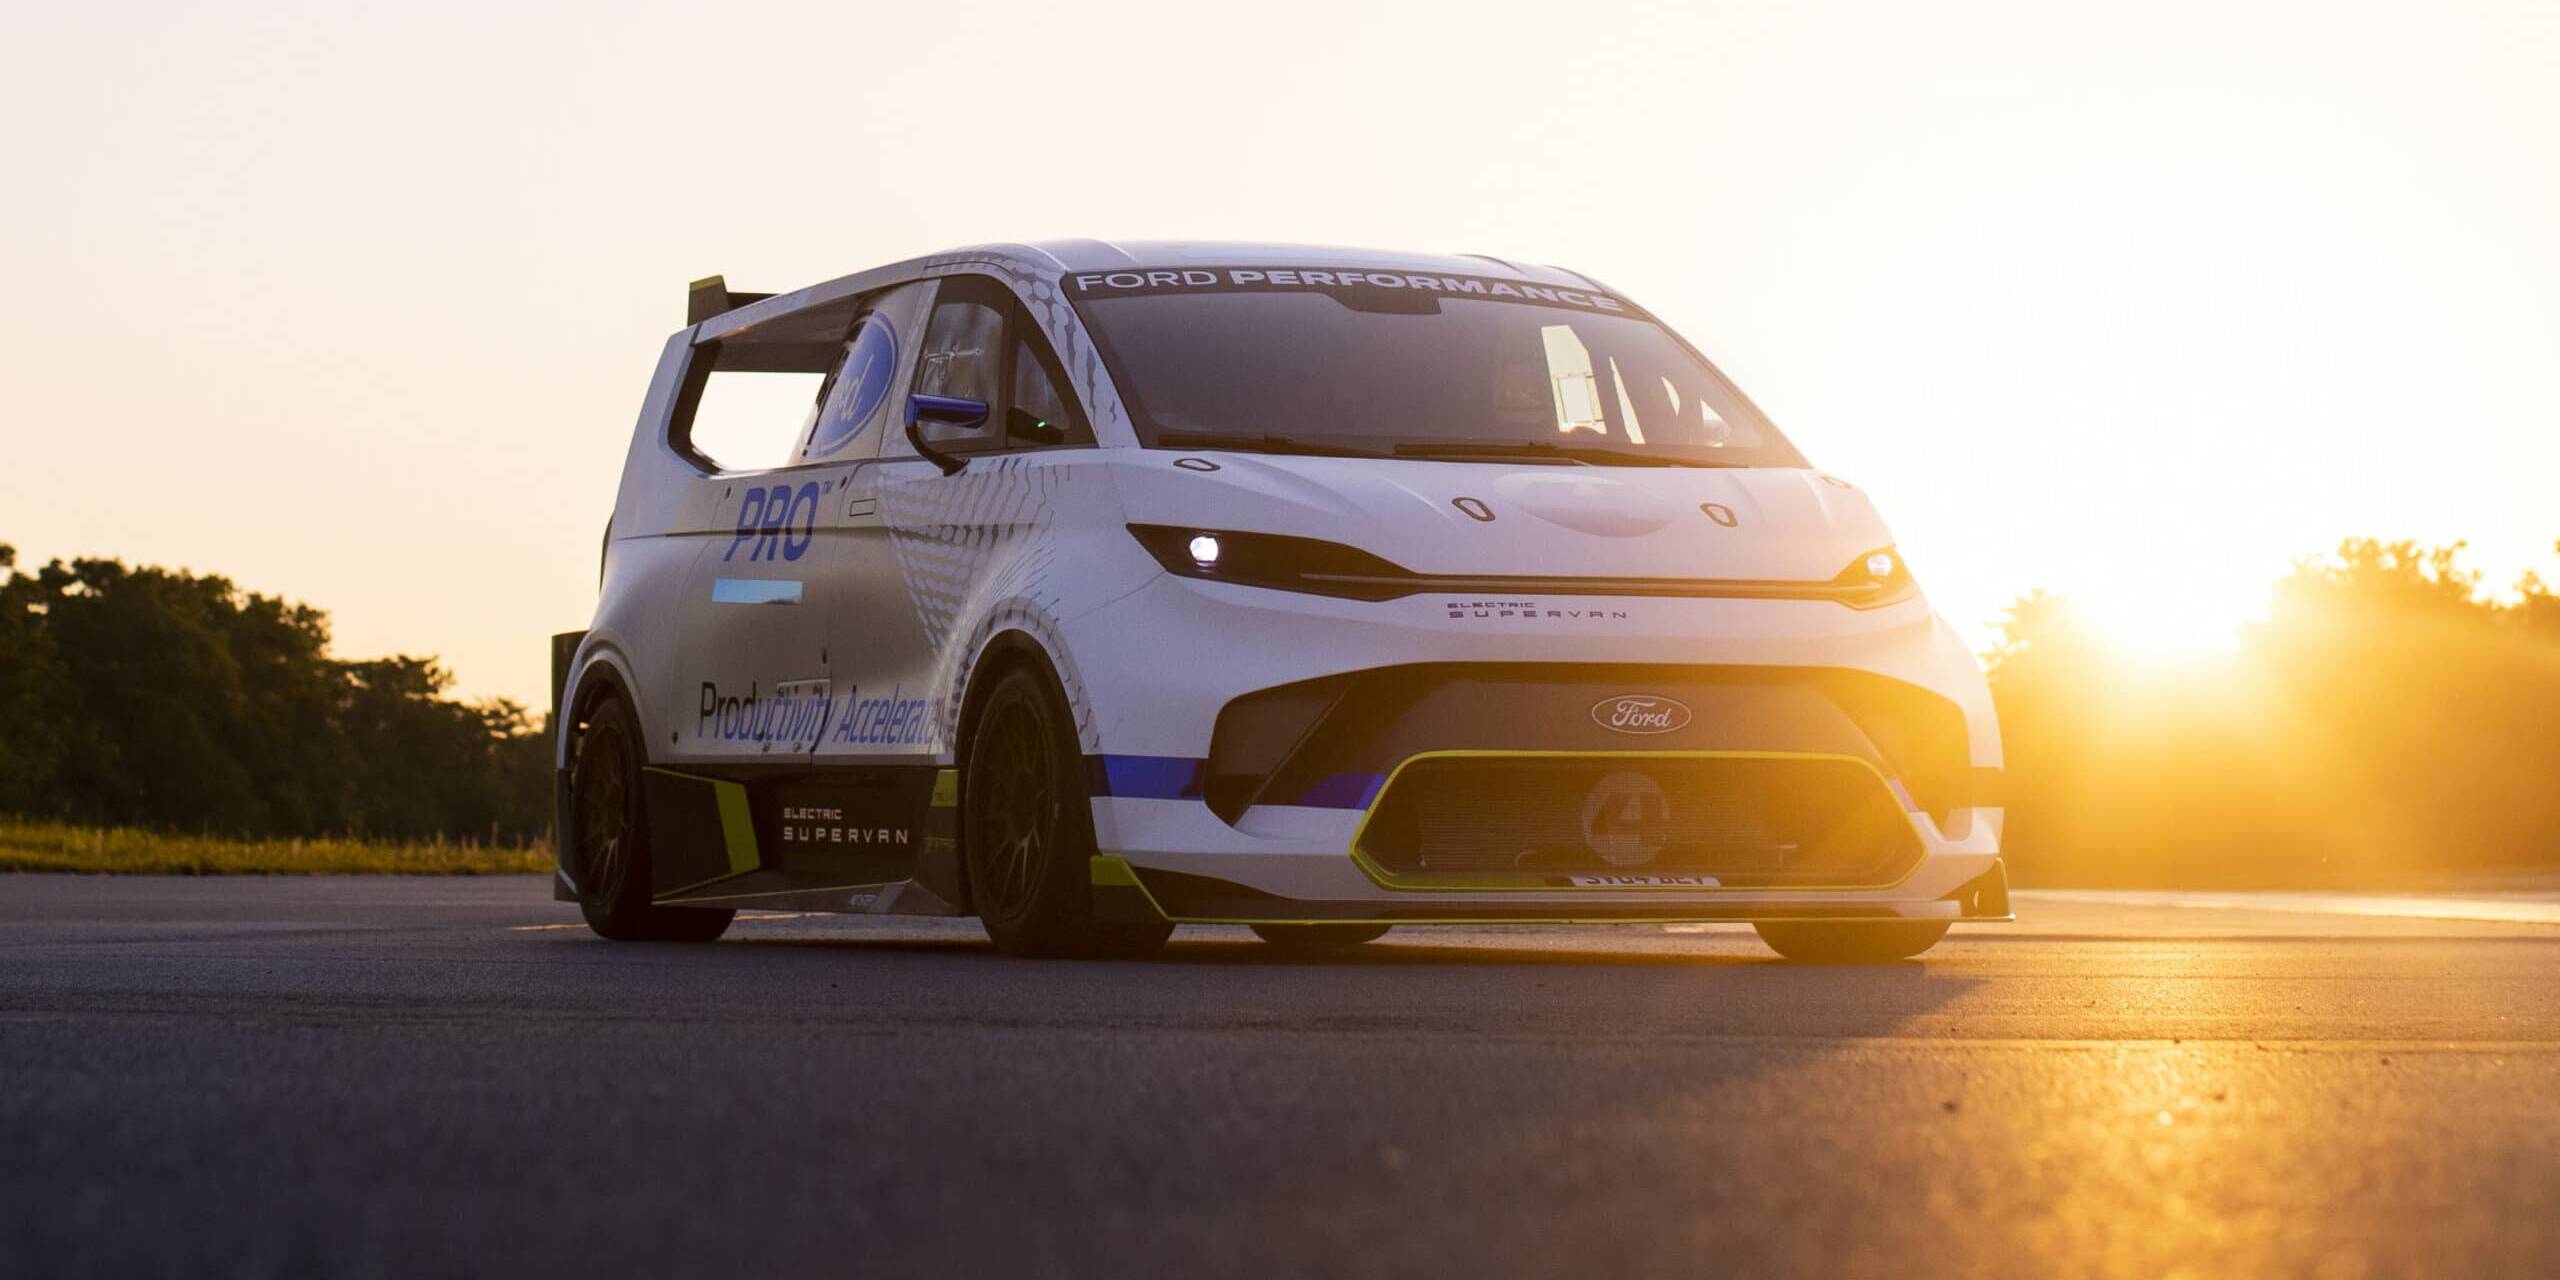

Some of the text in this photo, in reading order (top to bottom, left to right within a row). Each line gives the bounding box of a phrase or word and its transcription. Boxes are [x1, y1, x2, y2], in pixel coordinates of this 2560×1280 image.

[1076, 270, 1624, 312] FORD PERFORMANCE
[723, 481, 820, 561] PRO
[1449, 611, 1627, 619] SUPERVAN
[697, 680, 839, 752] Productivity
[1611, 699, 1673, 727] Ford
[783, 807, 842, 820] ELECTRIC
[783, 826, 908, 844] SUPERVAN
